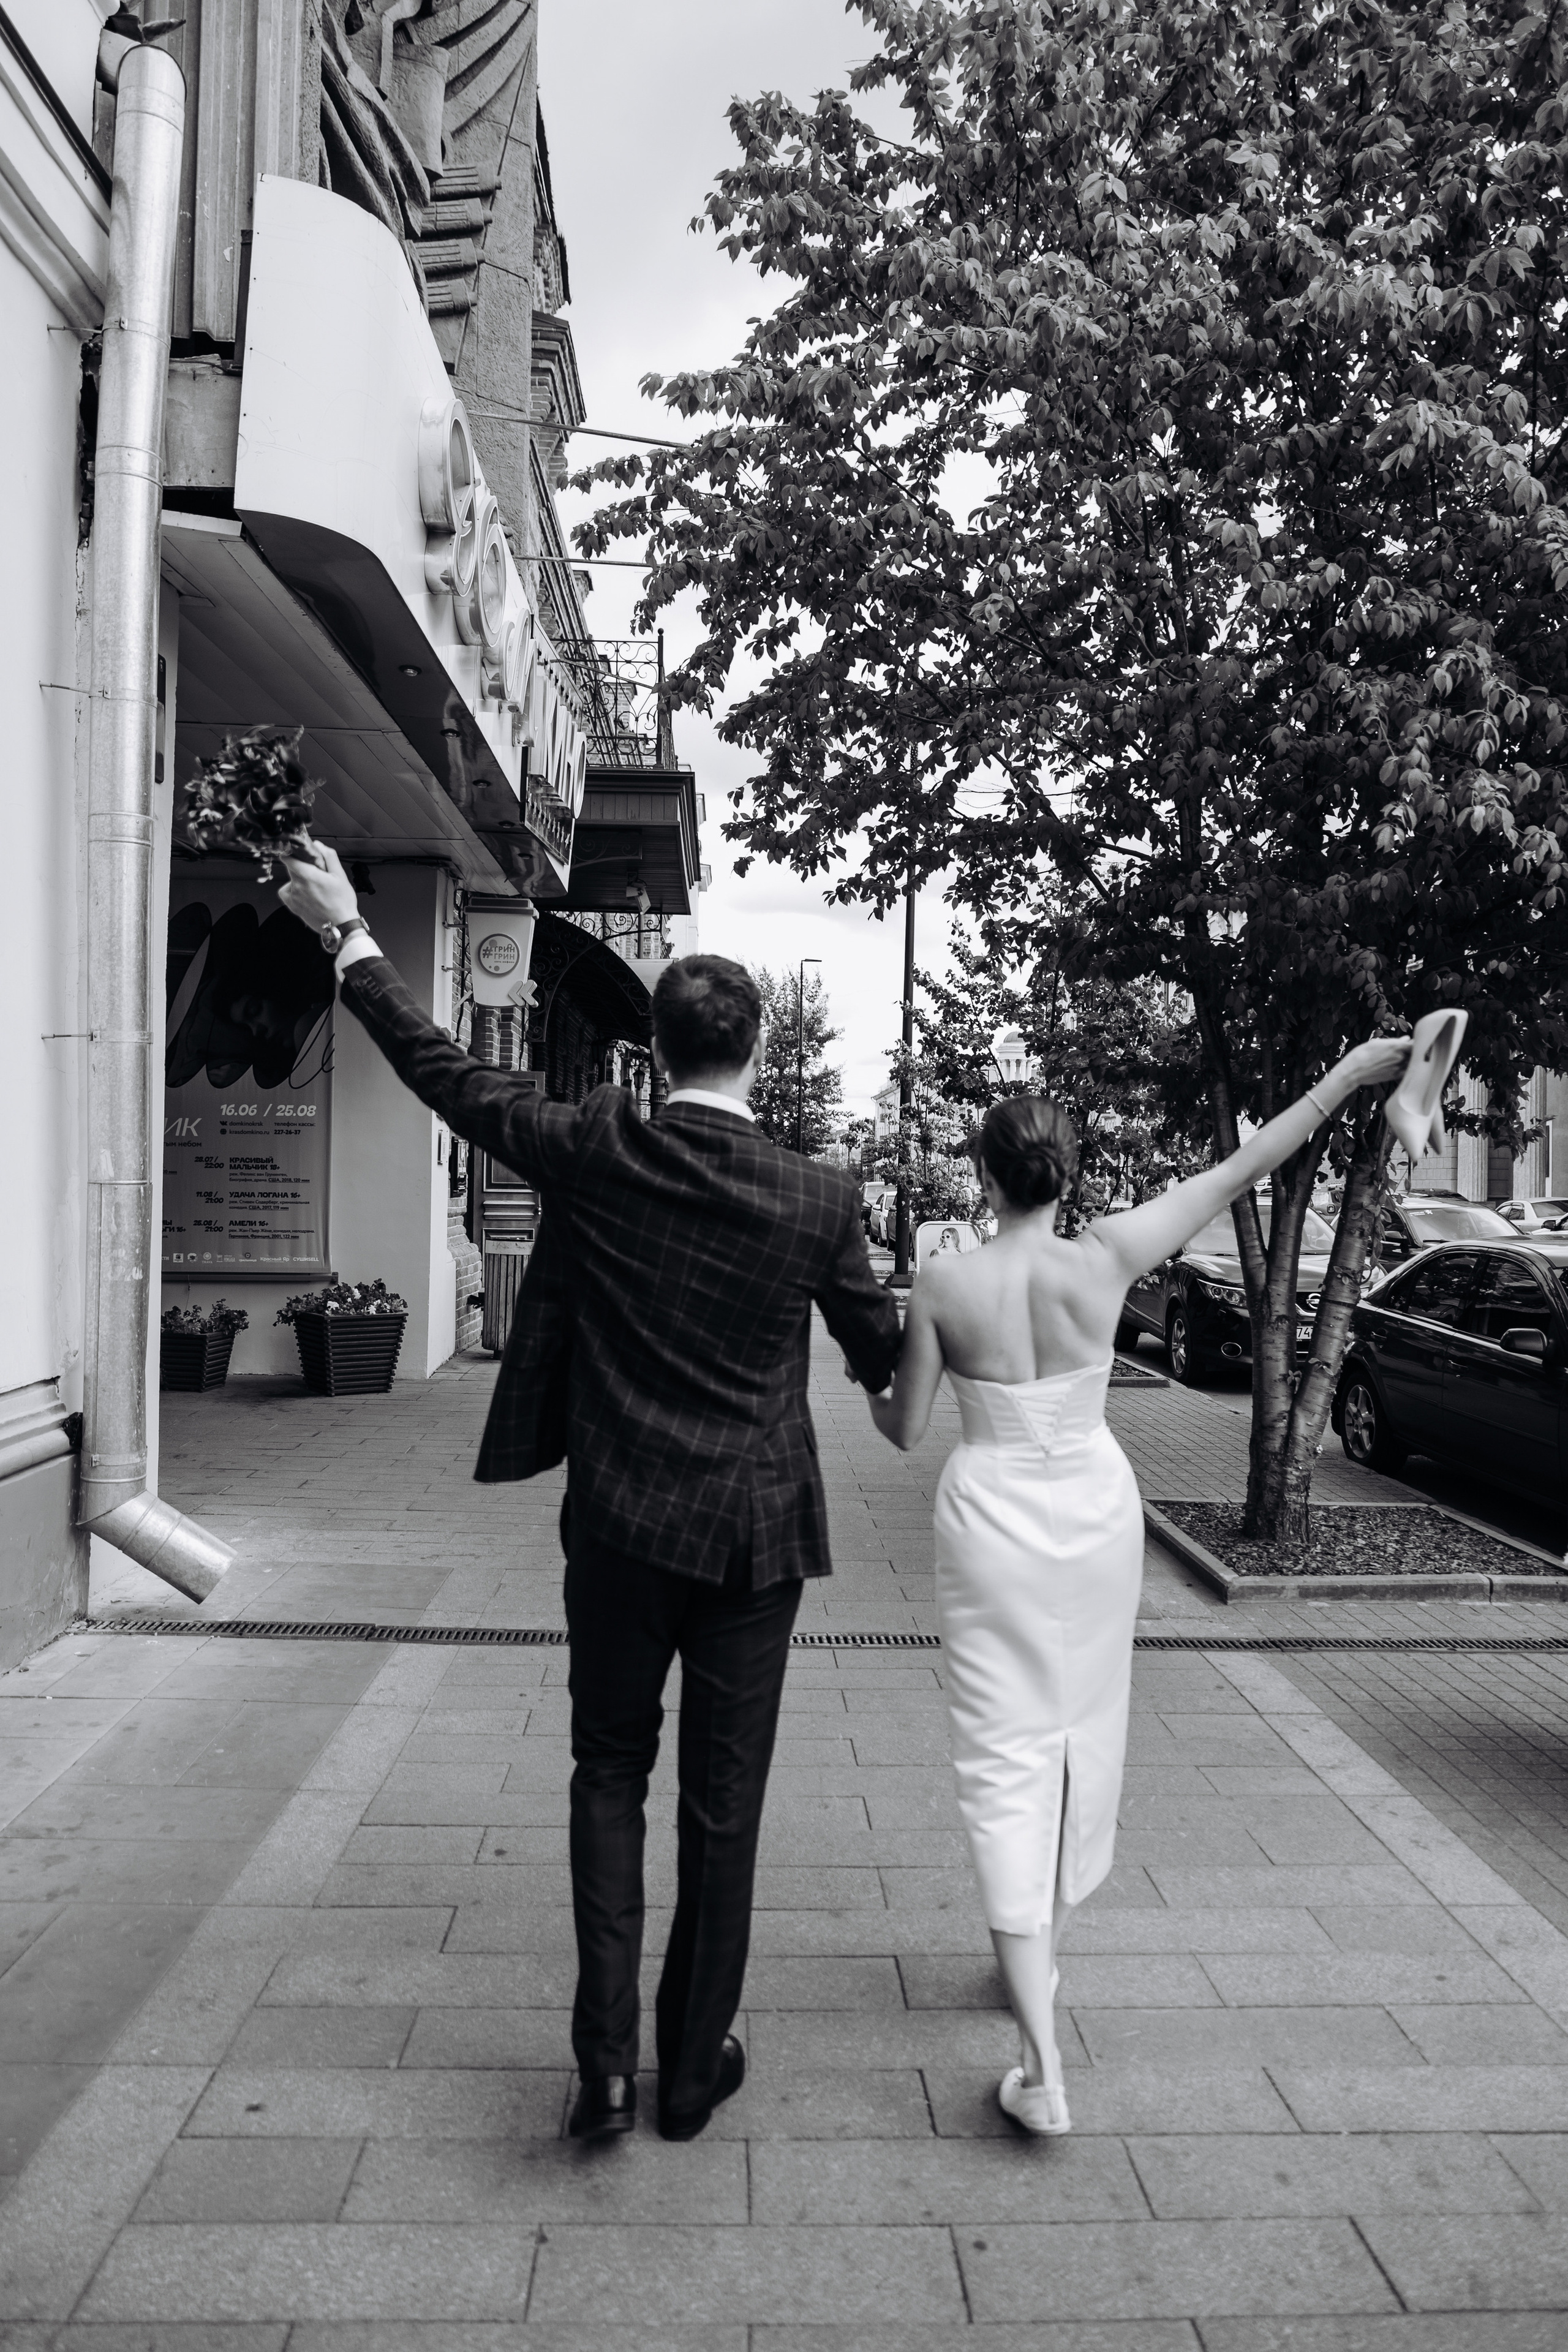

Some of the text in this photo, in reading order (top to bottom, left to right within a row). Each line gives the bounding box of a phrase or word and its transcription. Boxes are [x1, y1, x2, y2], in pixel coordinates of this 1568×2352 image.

[221, 1104, 257, 1116] 16.06
[276, 1104, 317, 1117] 25.08
[1297, 1327, 1314, 1338] 74
